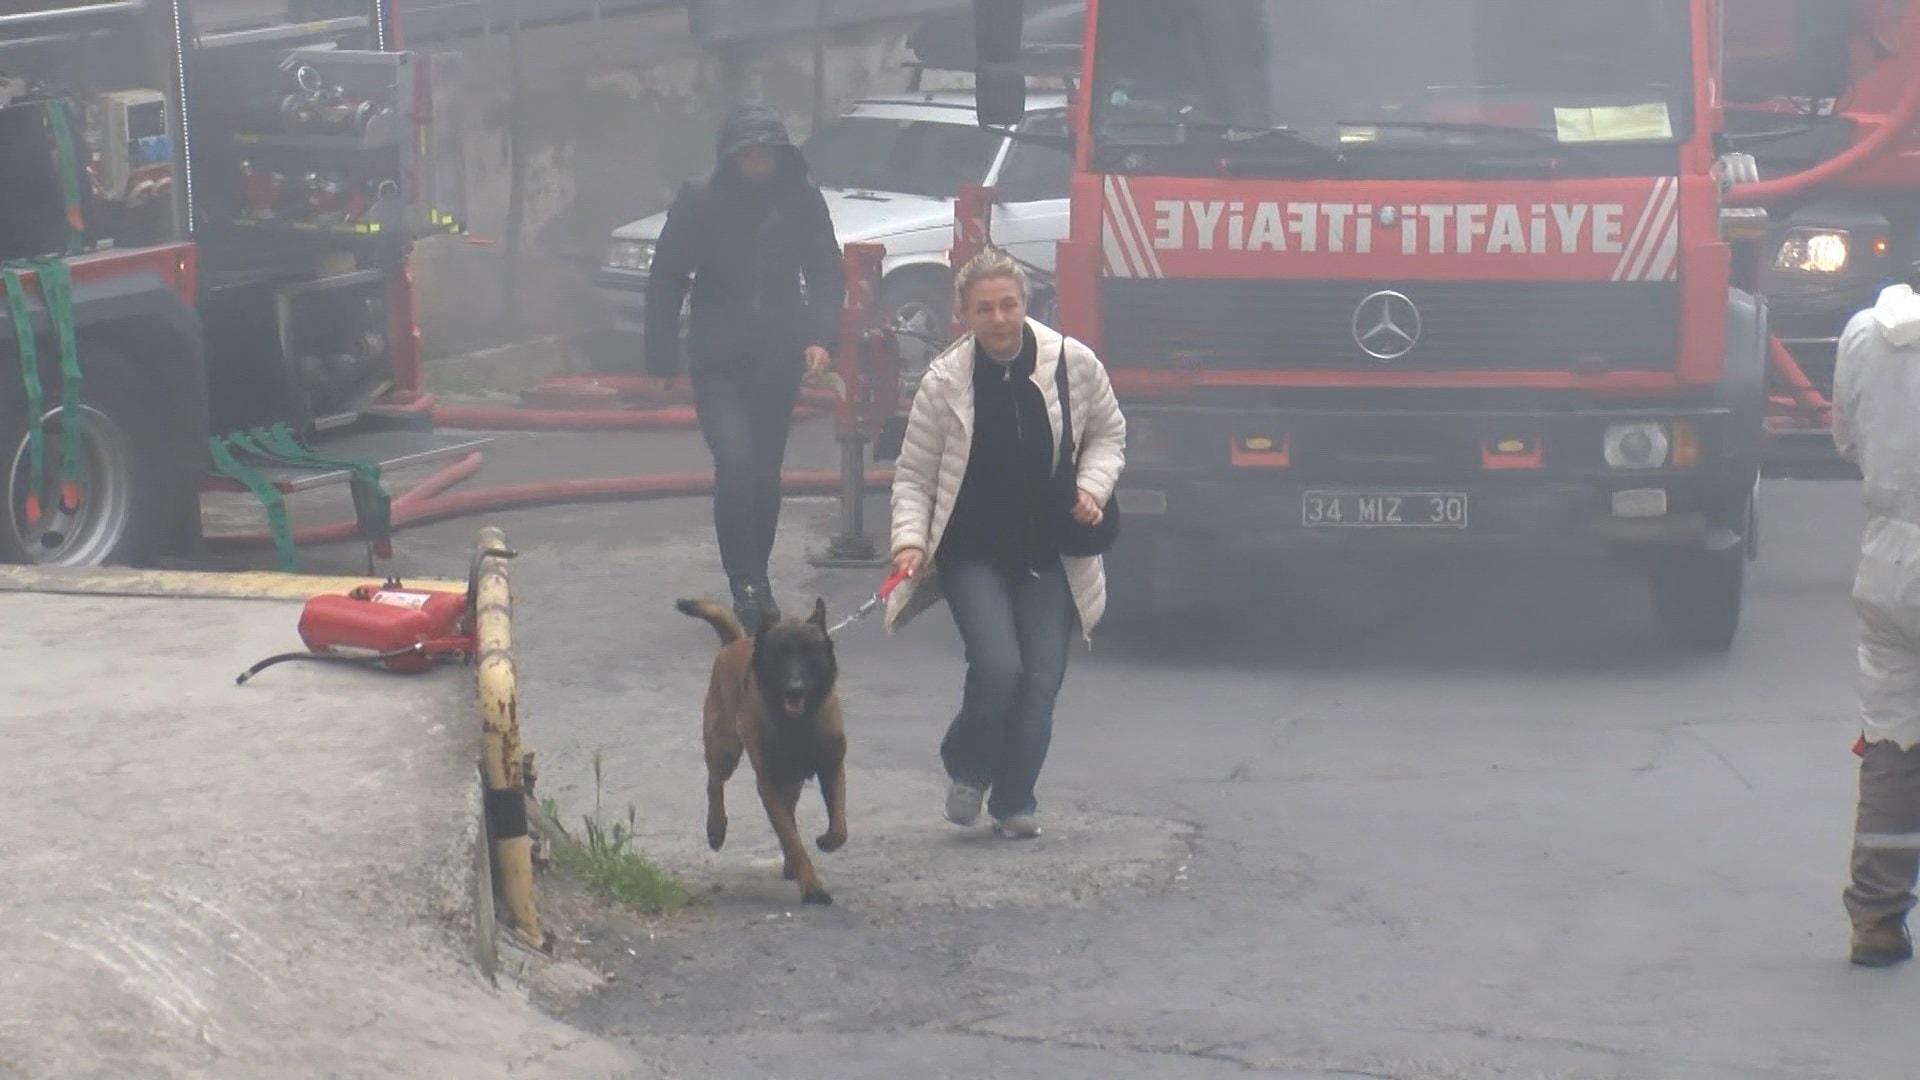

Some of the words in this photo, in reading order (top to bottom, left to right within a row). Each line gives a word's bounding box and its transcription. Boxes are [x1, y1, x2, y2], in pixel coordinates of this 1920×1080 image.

[1308, 497, 1343, 522] 34
[1359, 497, 1402, 522] MIZ
[1430, 497, 1462, 522] 30
